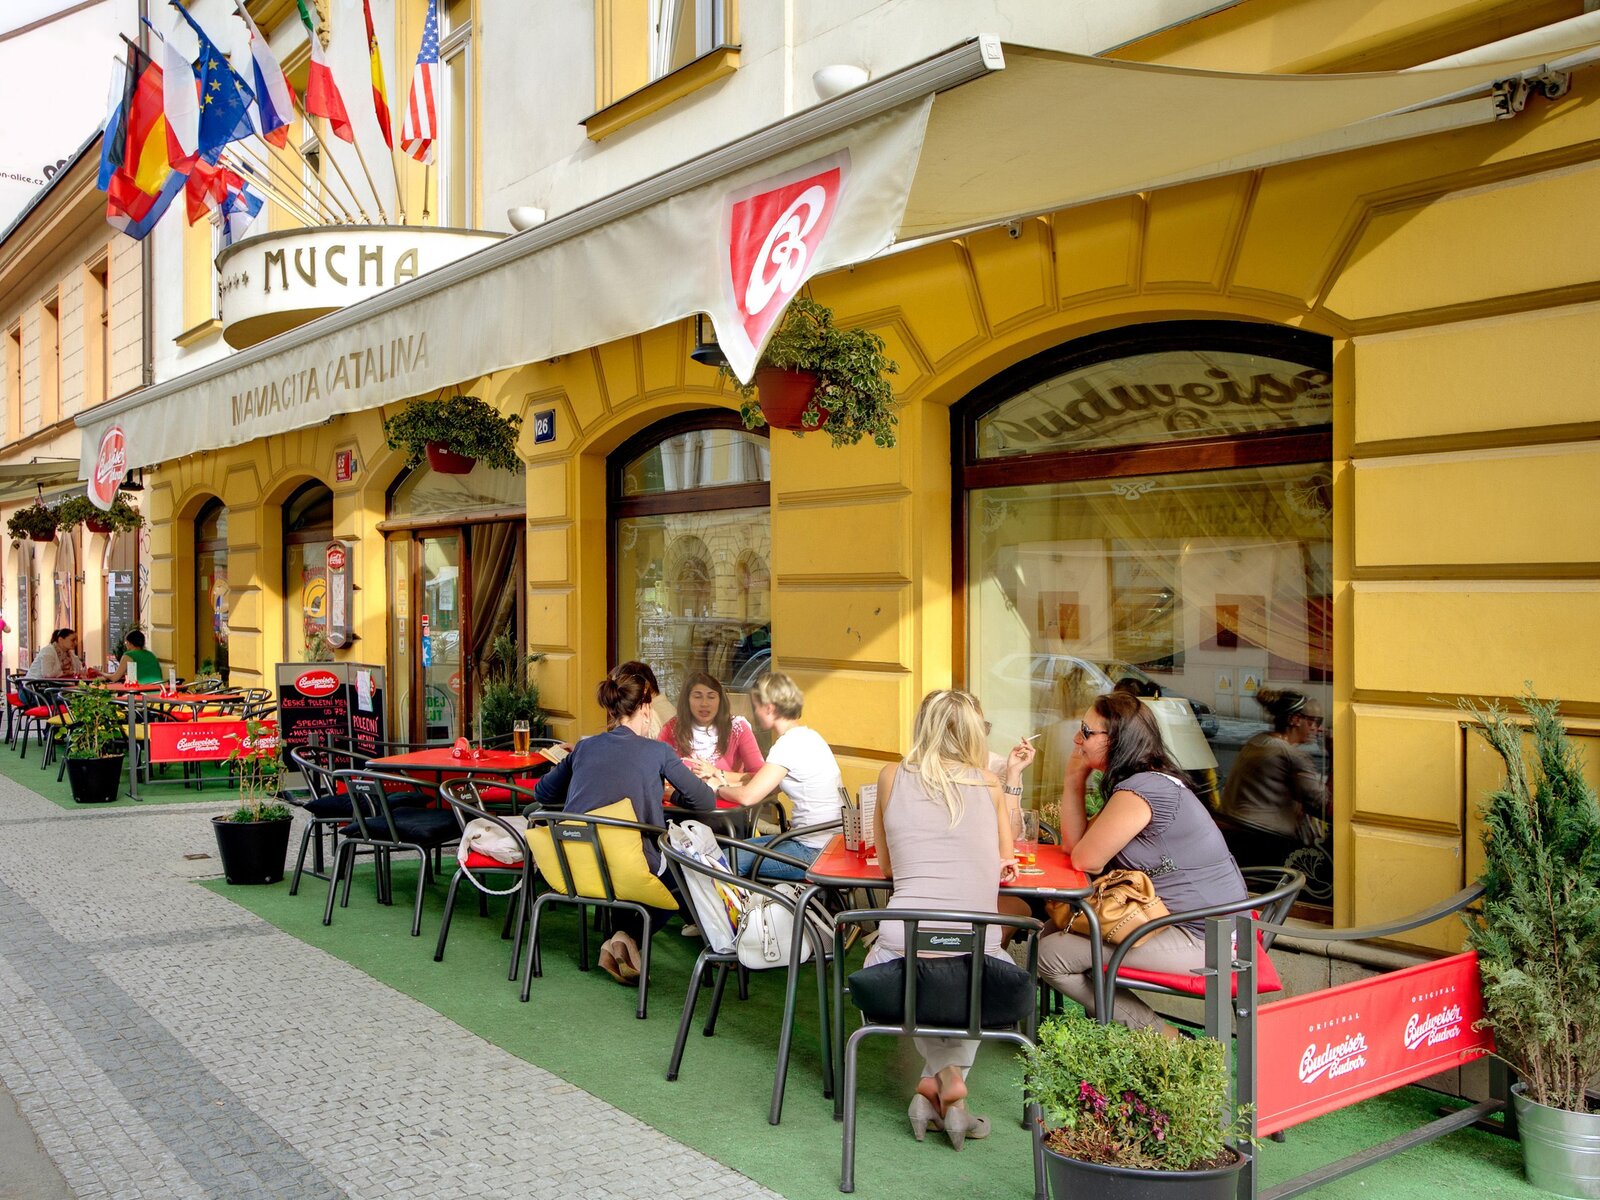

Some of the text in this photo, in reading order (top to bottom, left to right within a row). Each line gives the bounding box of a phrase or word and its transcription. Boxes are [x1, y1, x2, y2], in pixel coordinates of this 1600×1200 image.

[263, 244, 419, 294] MUCHA
[231, 331, 430, 427] MAMACITA CATALINA
[537, 417, 549, 436] 26
[1411, 985, 1456, 1004] ORIGINAL
[1309, 1012, 1360, 1033] ORIGINAL
[1404, 1003, 1463, 1050] Budweiser
[1427, 1025, 1461, 1046] Budvar
[1298, 1032, 1369, 1084] Budweiser
[1328, 1054, 1367, 1080] Budvar
